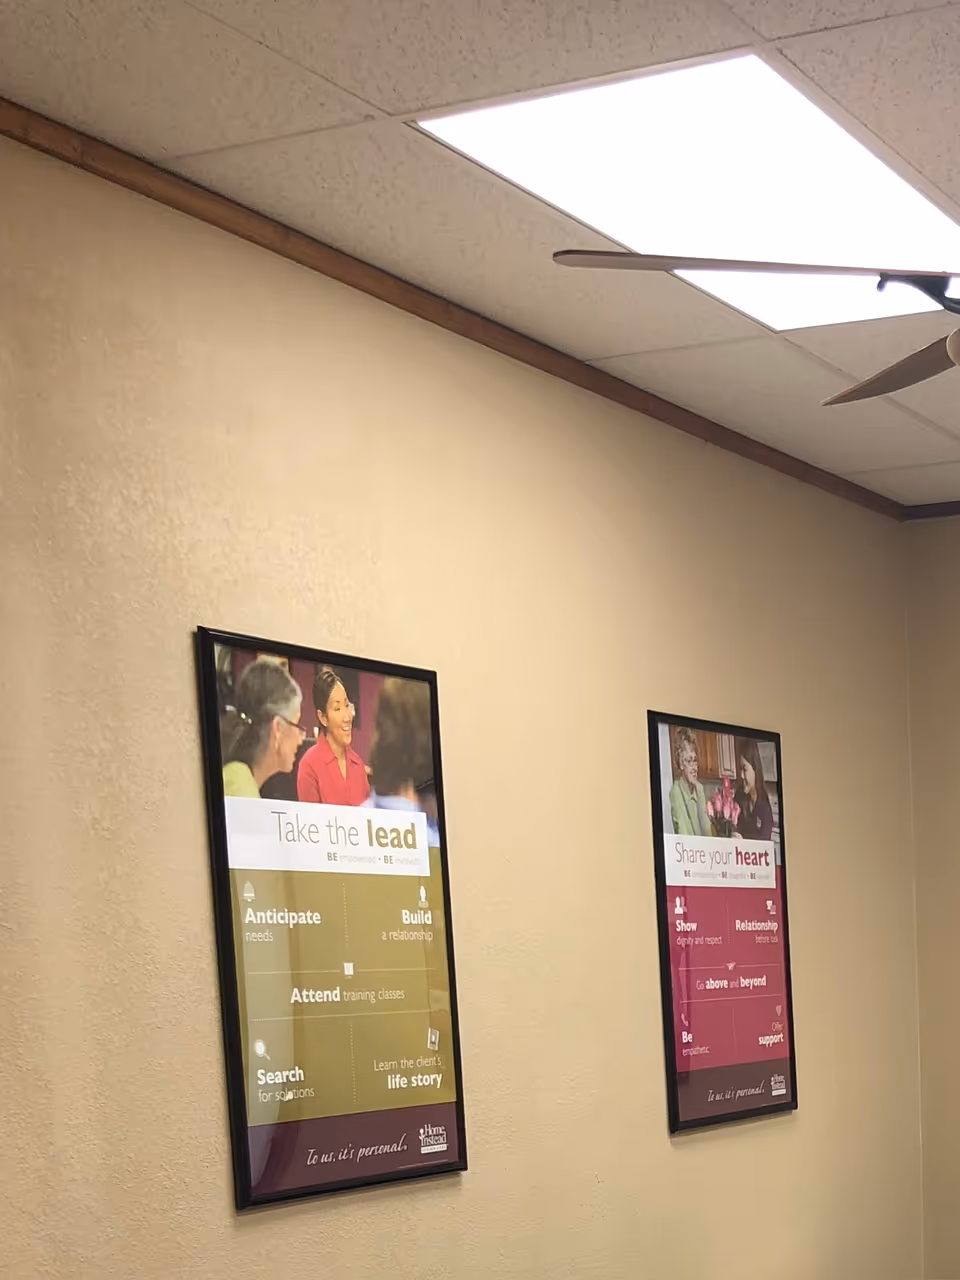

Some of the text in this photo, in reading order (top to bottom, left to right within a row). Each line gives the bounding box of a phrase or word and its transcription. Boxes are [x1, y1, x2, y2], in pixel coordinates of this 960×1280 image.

[271, 811, 418, 850] Take the lead
[327, 852, 338, 861] BE
[383, 855, 393, 864] BE
[675, 842, 770, 870] Share your heart
[245, 907, 321, 928] Anticipate
[402, 909, 432, 925] Build
[675, 920, 698, 932] Show
[735, 919, 778, 935] Relationship
[245, 930, 274, 943] needs
[382, 928, 433, 944] a relationship
[696, 980, 705, 990] Go
[705, 977, 729, 990] above
[740, 975, 767, 990] beyond
[290, 986, 405, 1004] Attend training classes
[681, 1031, 693, 1043] Be
[758, 1032, 784, 1048] support
[373, 1059, 398, 1072] Learn
[400, 1057, 414, 1070] the
[257, 1065, 305, 1086] Search
[387, 1072, 443, 1089] life story
[258, 1088, 272, 1103] for
[424, 1124, 445, 1136] Home
[306, 1148, 322, 1166] To
[324, 1150, 337, 1163] us,
[338, 1143, 355, 1161] it's
[357, 1133, 408, 1163] personal.
